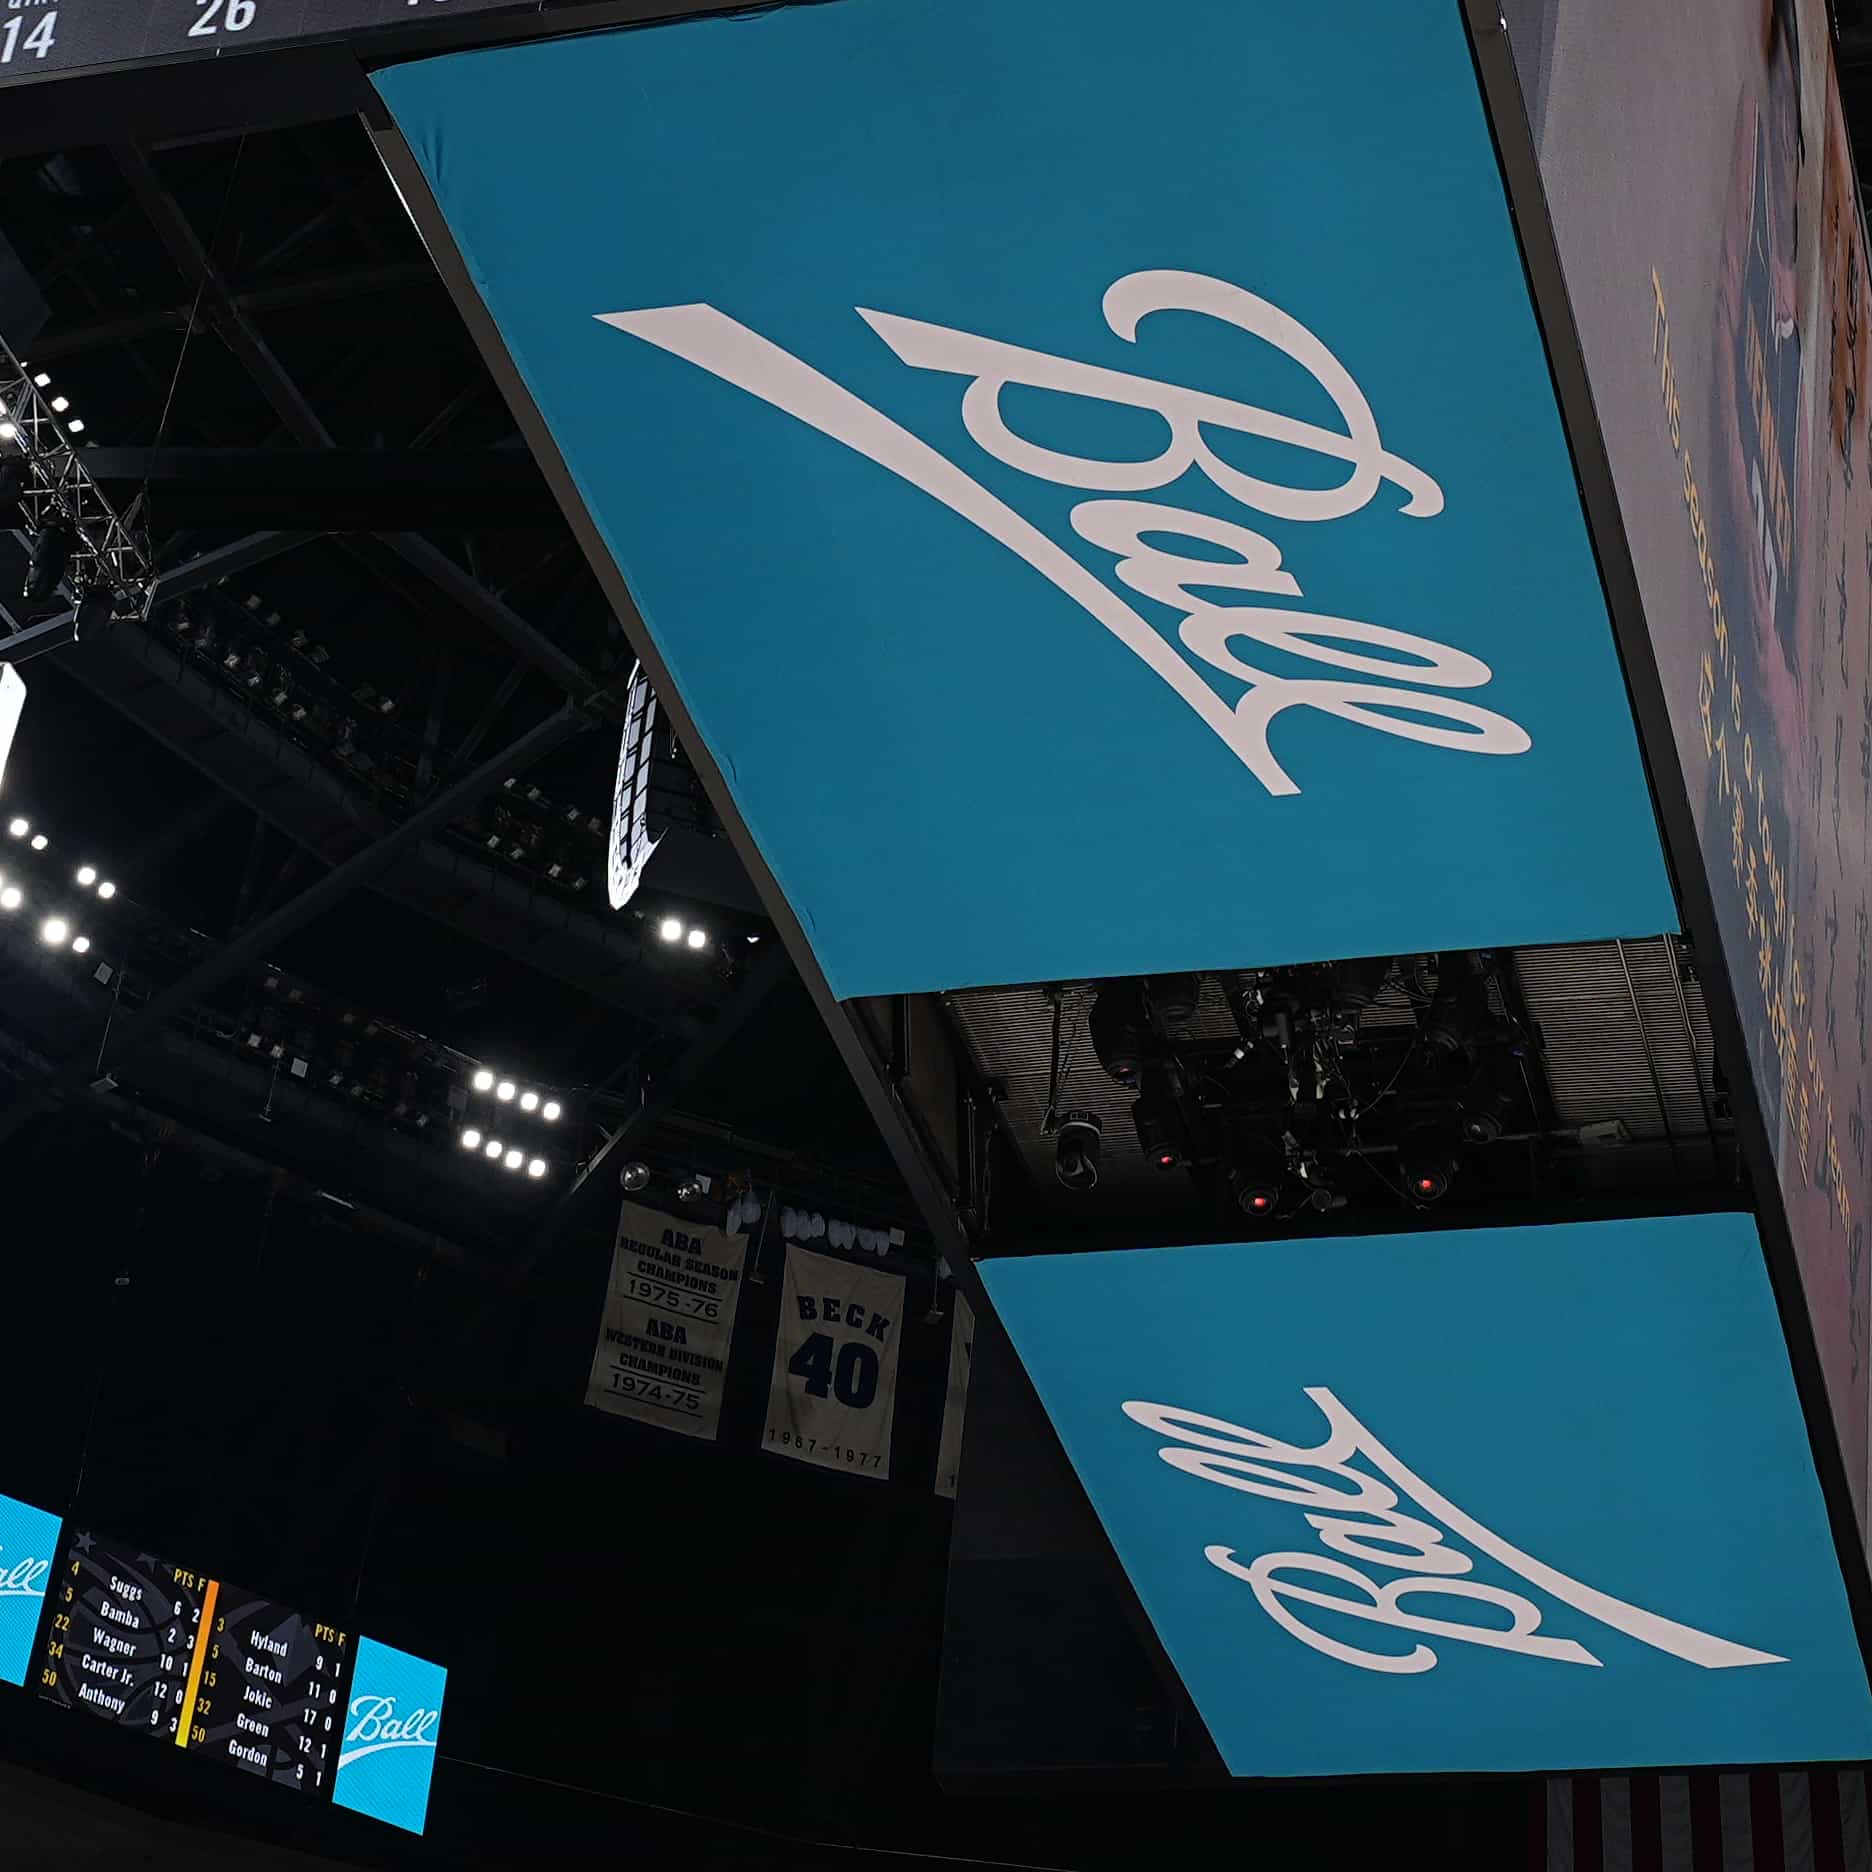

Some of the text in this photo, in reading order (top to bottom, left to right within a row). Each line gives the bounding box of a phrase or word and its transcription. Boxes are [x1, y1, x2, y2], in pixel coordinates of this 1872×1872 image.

[0, 11, 57, 66] 14
[591, 269, 1532, 798] Ball
[796, 1294, 892, 1342] BECK
[788, 1330, 881, 1410] 40
[1122, 1385, 1791, 1676] Ball
[109, 1574, 143, 1603] Suggs
[173, 1568, 194, 1590] PTS
[54, 1613, 137, 1659] 22 Wagner
[100, 1600, 140, 1630] Bamba
[314, 1623, 335, 1645] PTS
[47, 1640, 135, 1689] 34 Carter Jr.
[250, 1629, 288, 1659] Hyland
[41, 1668, 126, 1716] 50 Anthony
[202, 1669, 273, 1711] 15 Jokic
[244, 1656, 283, 1685] Barton
[196, 1697, 270, 1739] 32 Green
[338, 1695, 439, 1770] Ball
[190, 1723, 268, 1769] 50 Gordon
